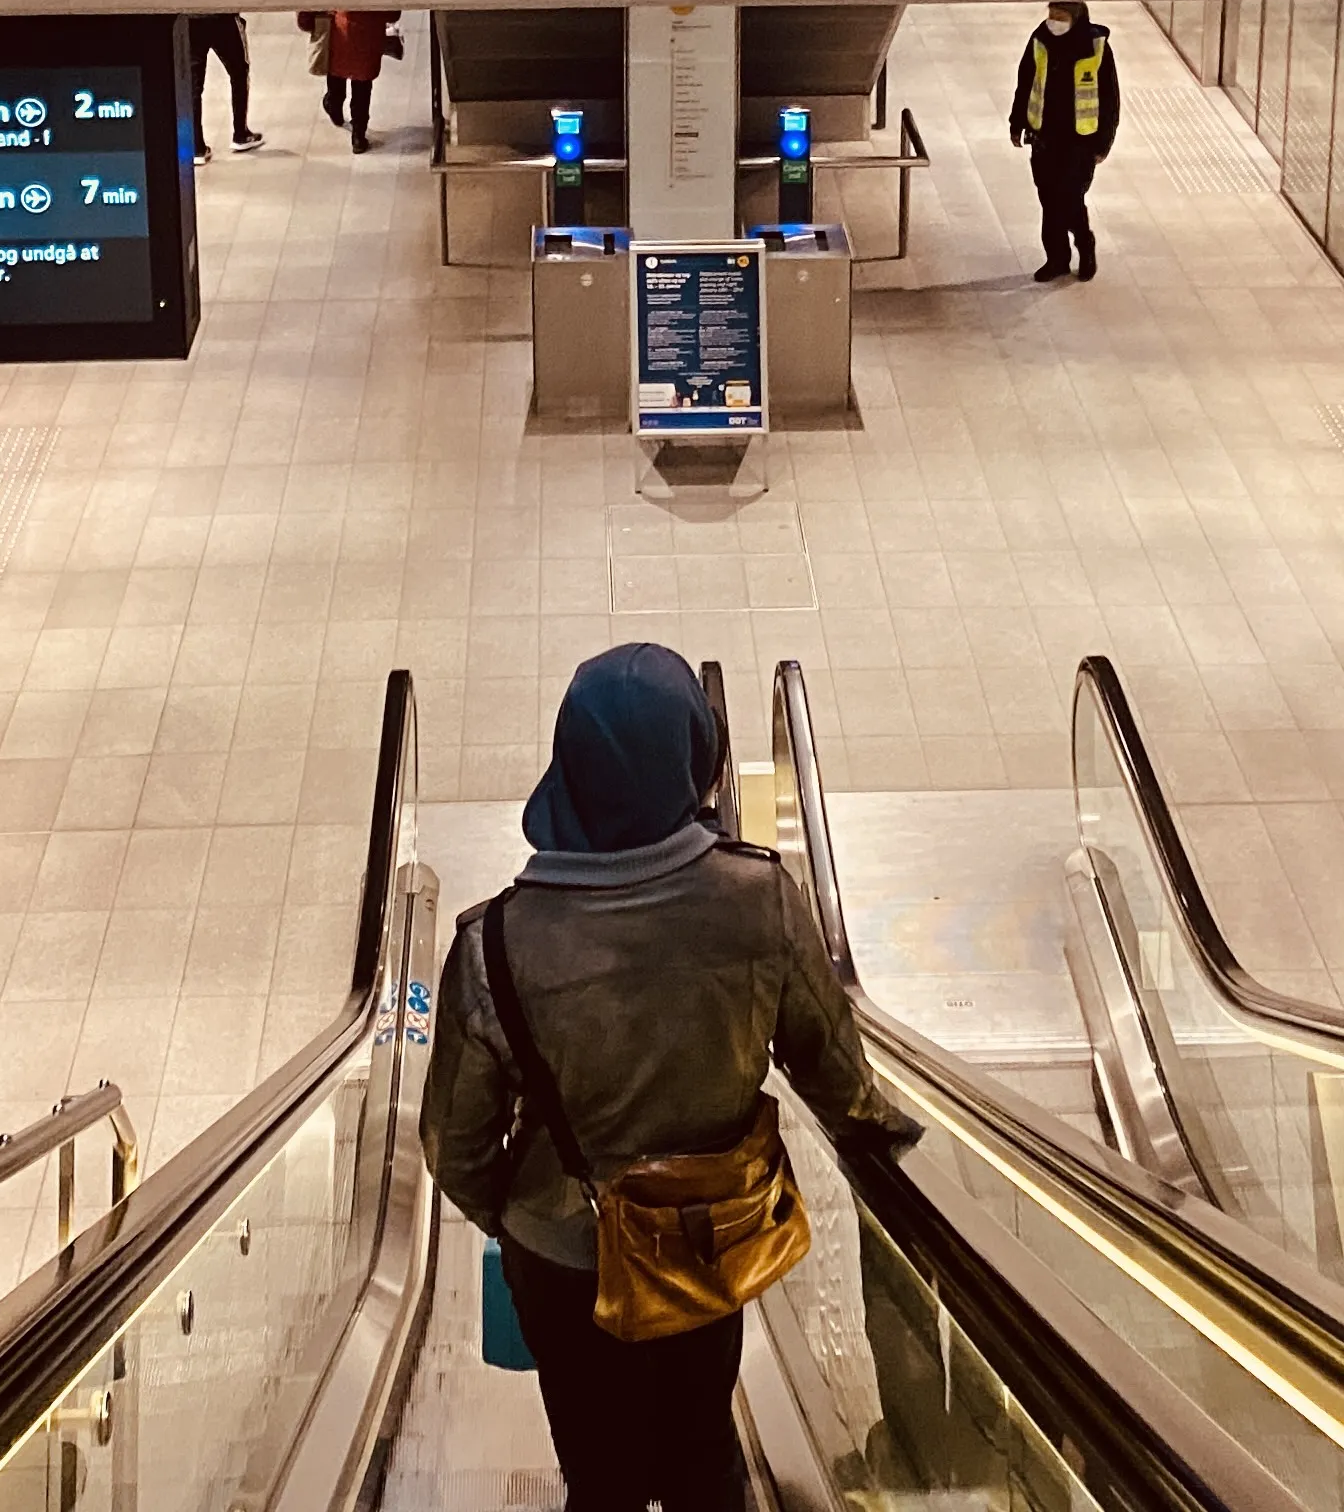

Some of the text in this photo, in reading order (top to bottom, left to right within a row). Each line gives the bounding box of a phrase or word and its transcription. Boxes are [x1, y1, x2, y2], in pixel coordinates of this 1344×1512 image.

[74, 92, 95, 119] 2
[98, 101, 134, 119] min
[80, 178, 100, 205] 7
[103, 187, 138, 205] min
[21, 244, 77, 265] undgå
[80, 245, 100, 261] at
